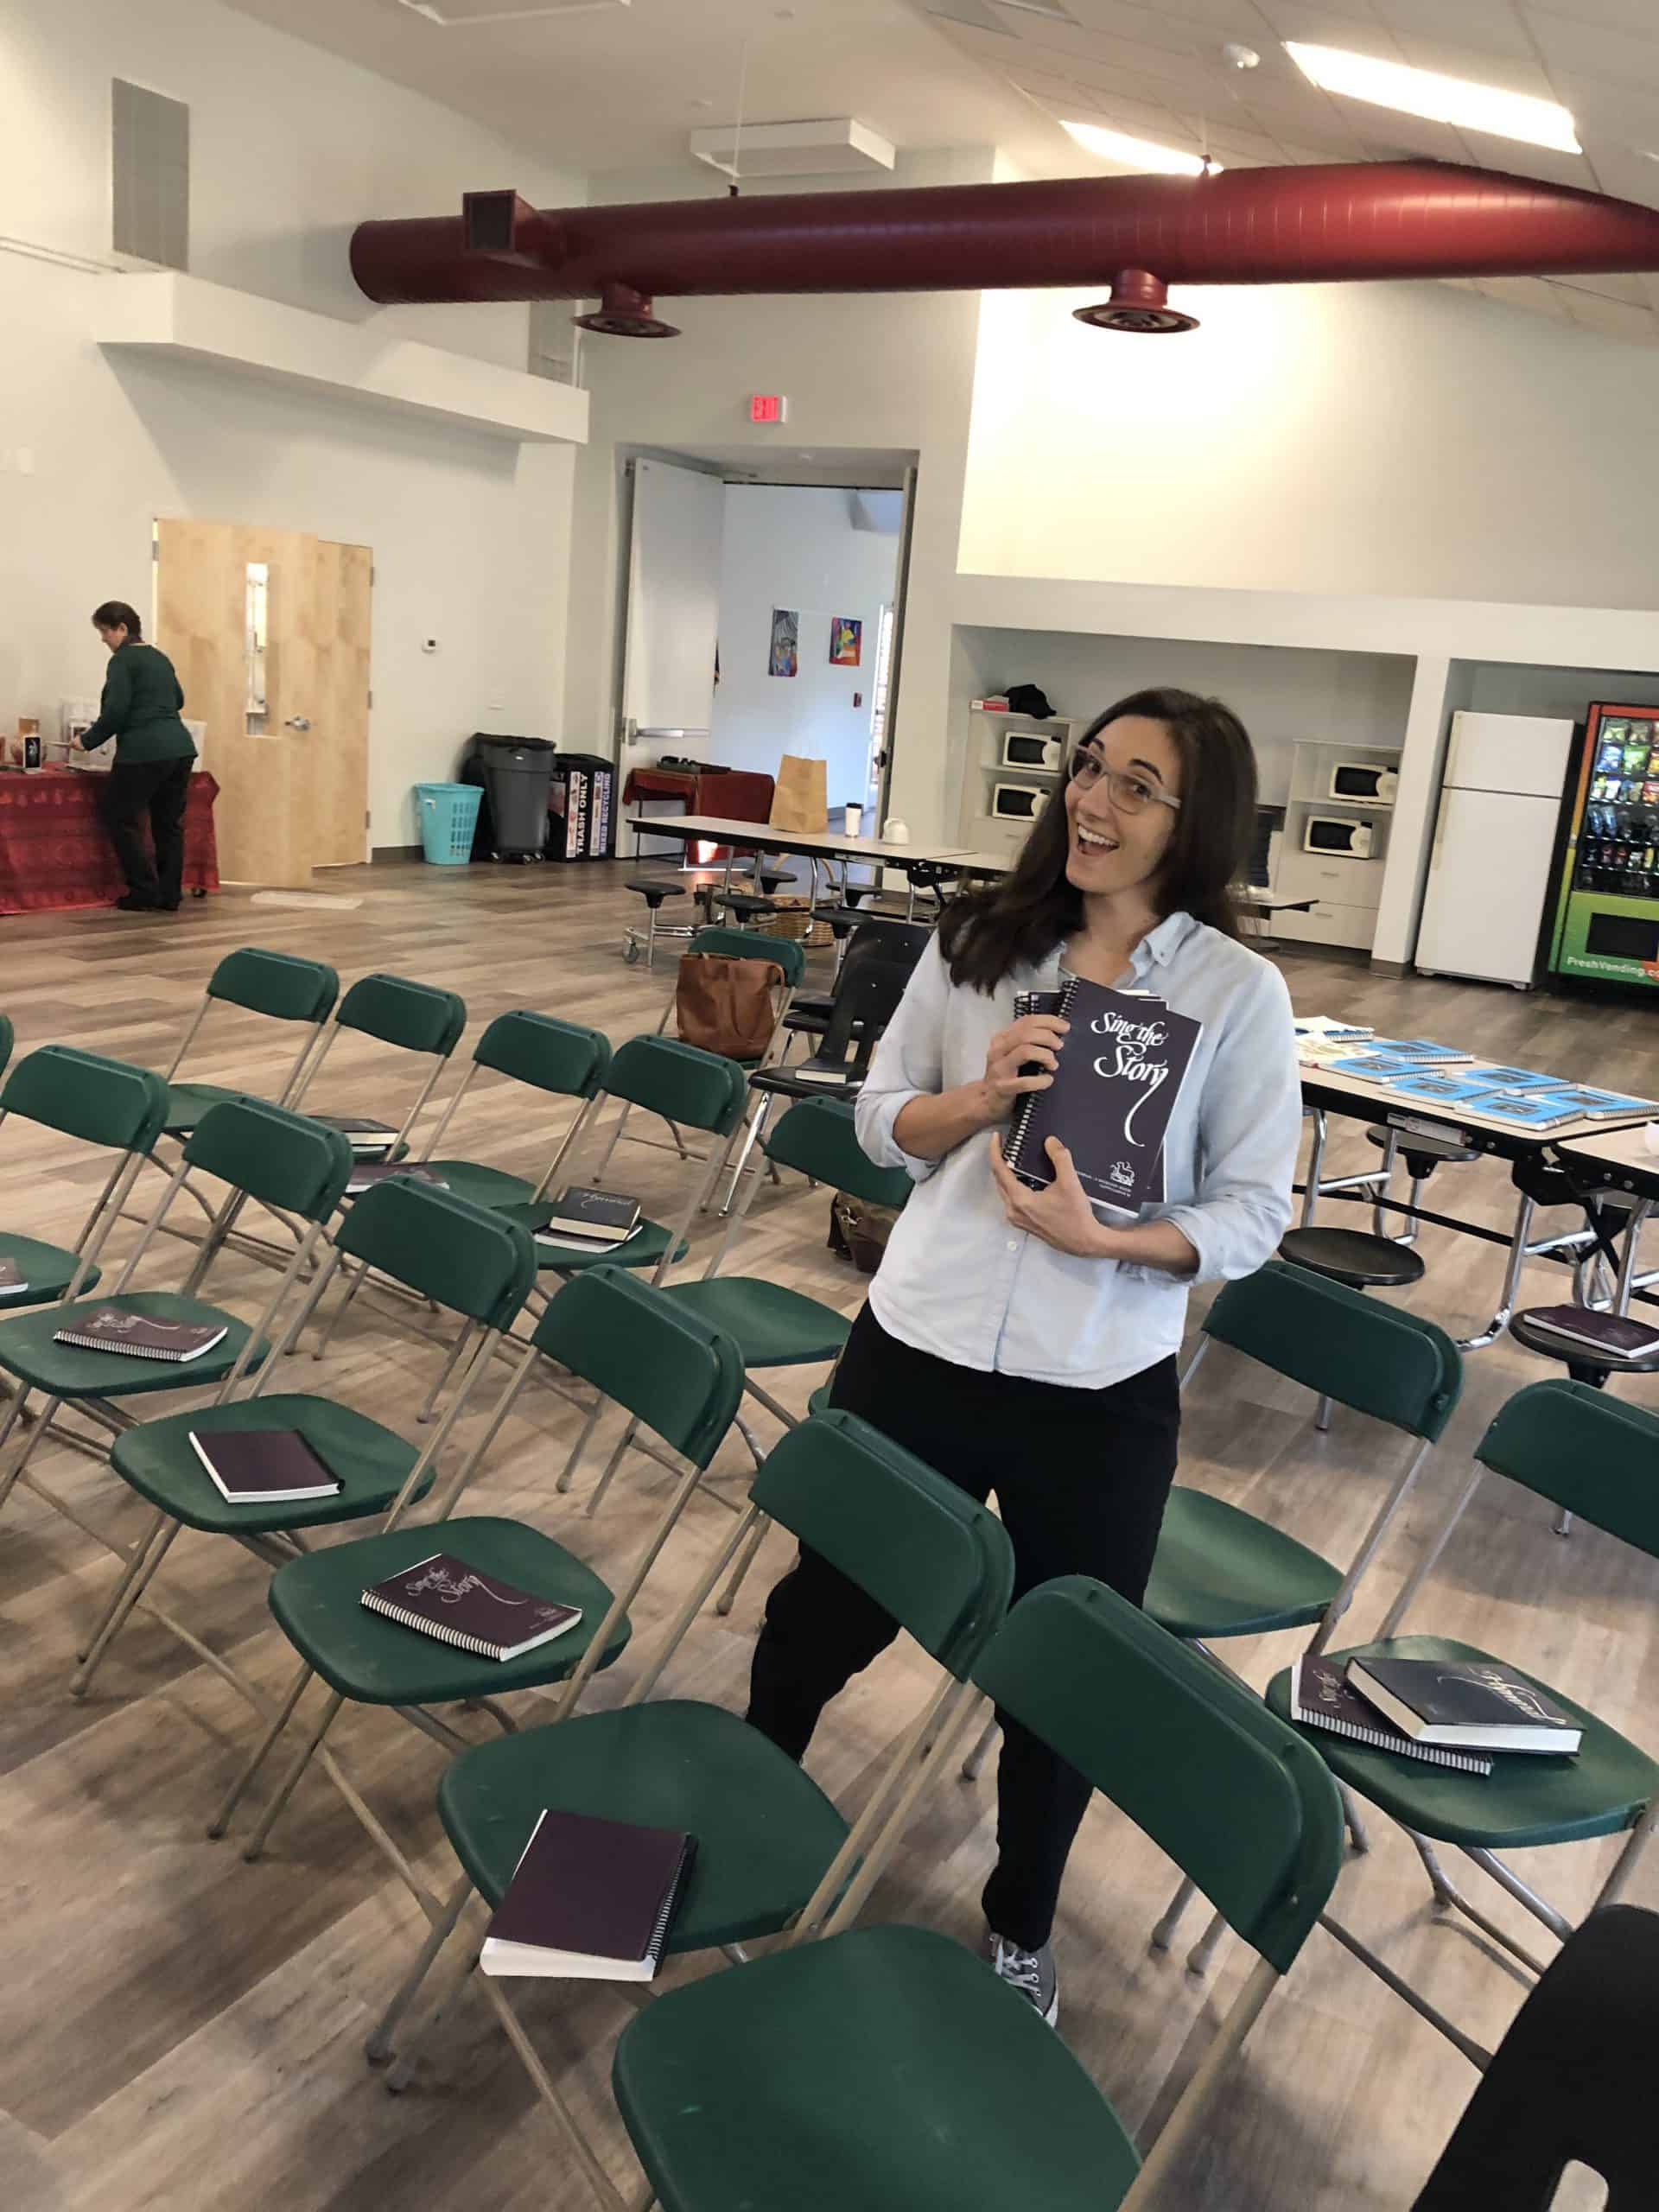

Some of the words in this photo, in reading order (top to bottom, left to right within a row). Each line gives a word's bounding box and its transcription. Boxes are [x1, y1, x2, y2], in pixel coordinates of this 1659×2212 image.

[580, 773, 588, 808] ONLY
[601, 772, 611, 823] RECYCLING
[576, 812, 586, 854] TRASH
[1090, 1012, 1147, 1056] Sing
[1136, 1021, 1169, 1046] the
